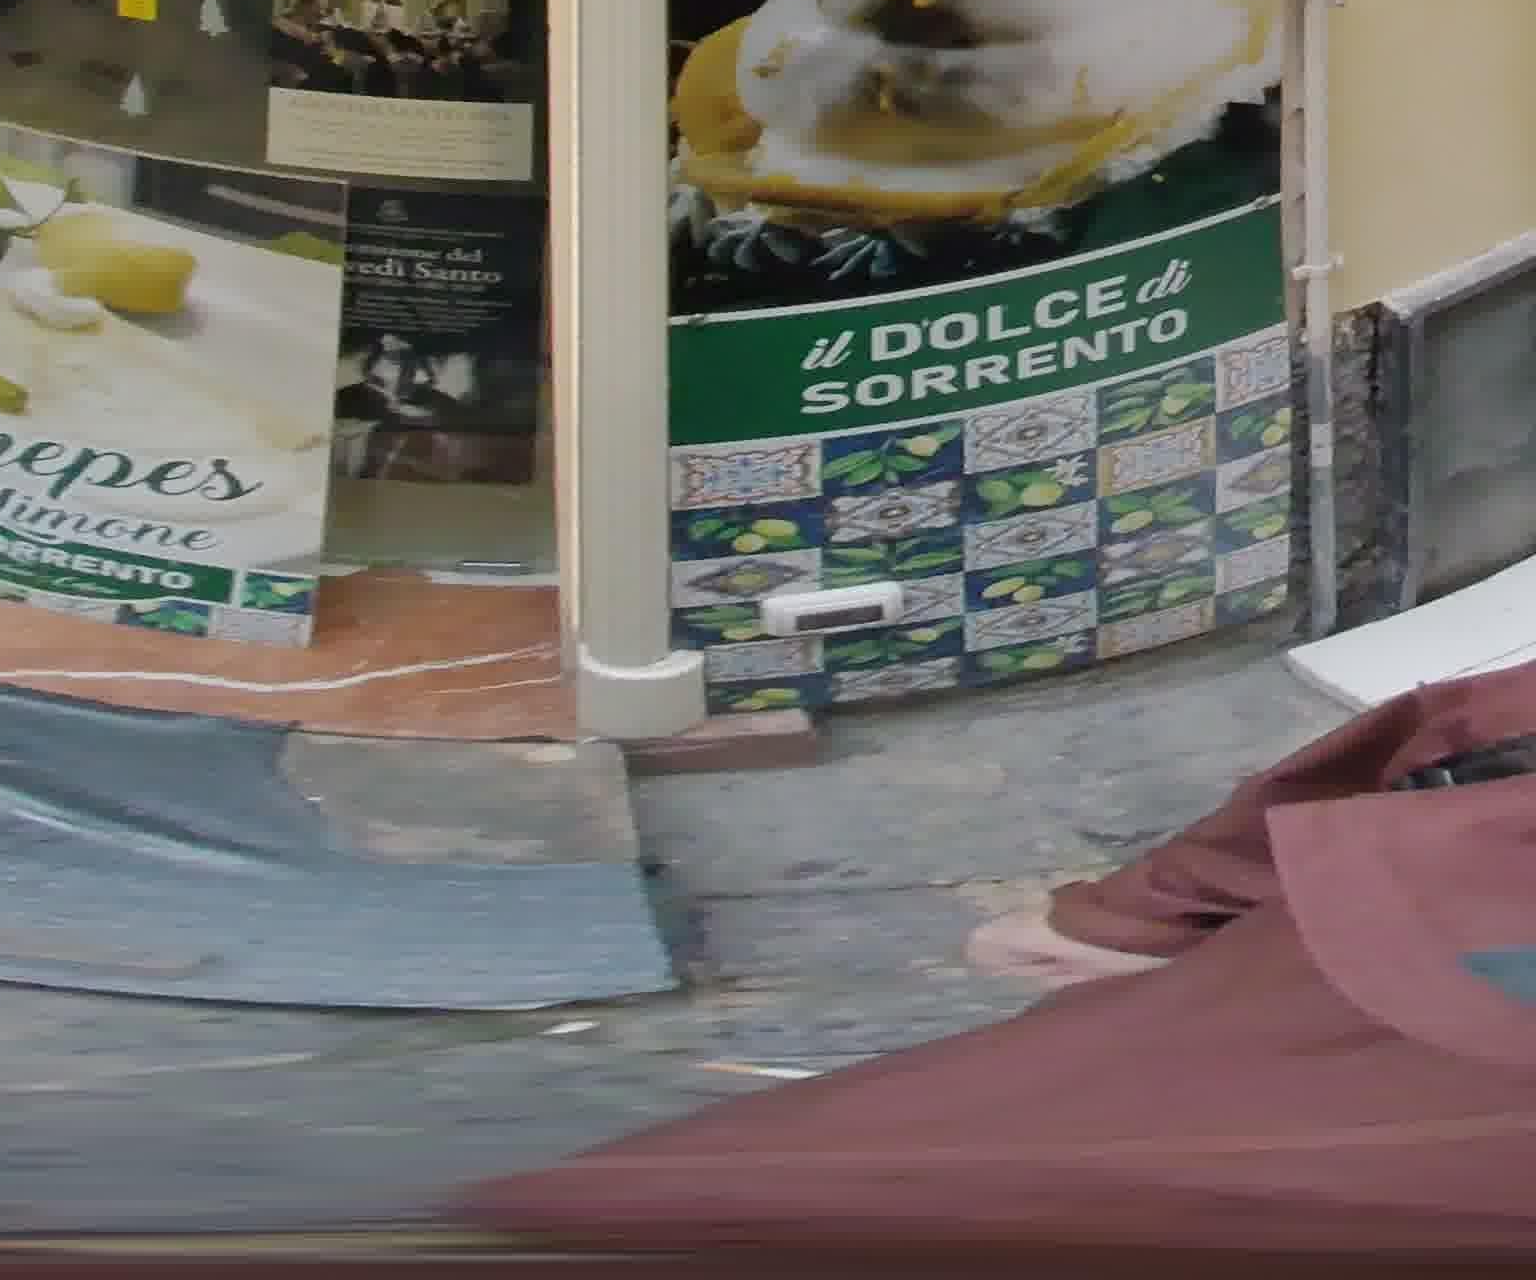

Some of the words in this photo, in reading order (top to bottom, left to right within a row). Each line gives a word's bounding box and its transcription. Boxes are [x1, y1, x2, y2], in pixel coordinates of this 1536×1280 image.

[414, 261, 504, 283] Santo
[801, 328, 852, 371] il
[870, 275, 1129, 364] DOLCE
[1134, 259, 1193, 306] di
[800, 307, 1191, 417] SORRENTO
